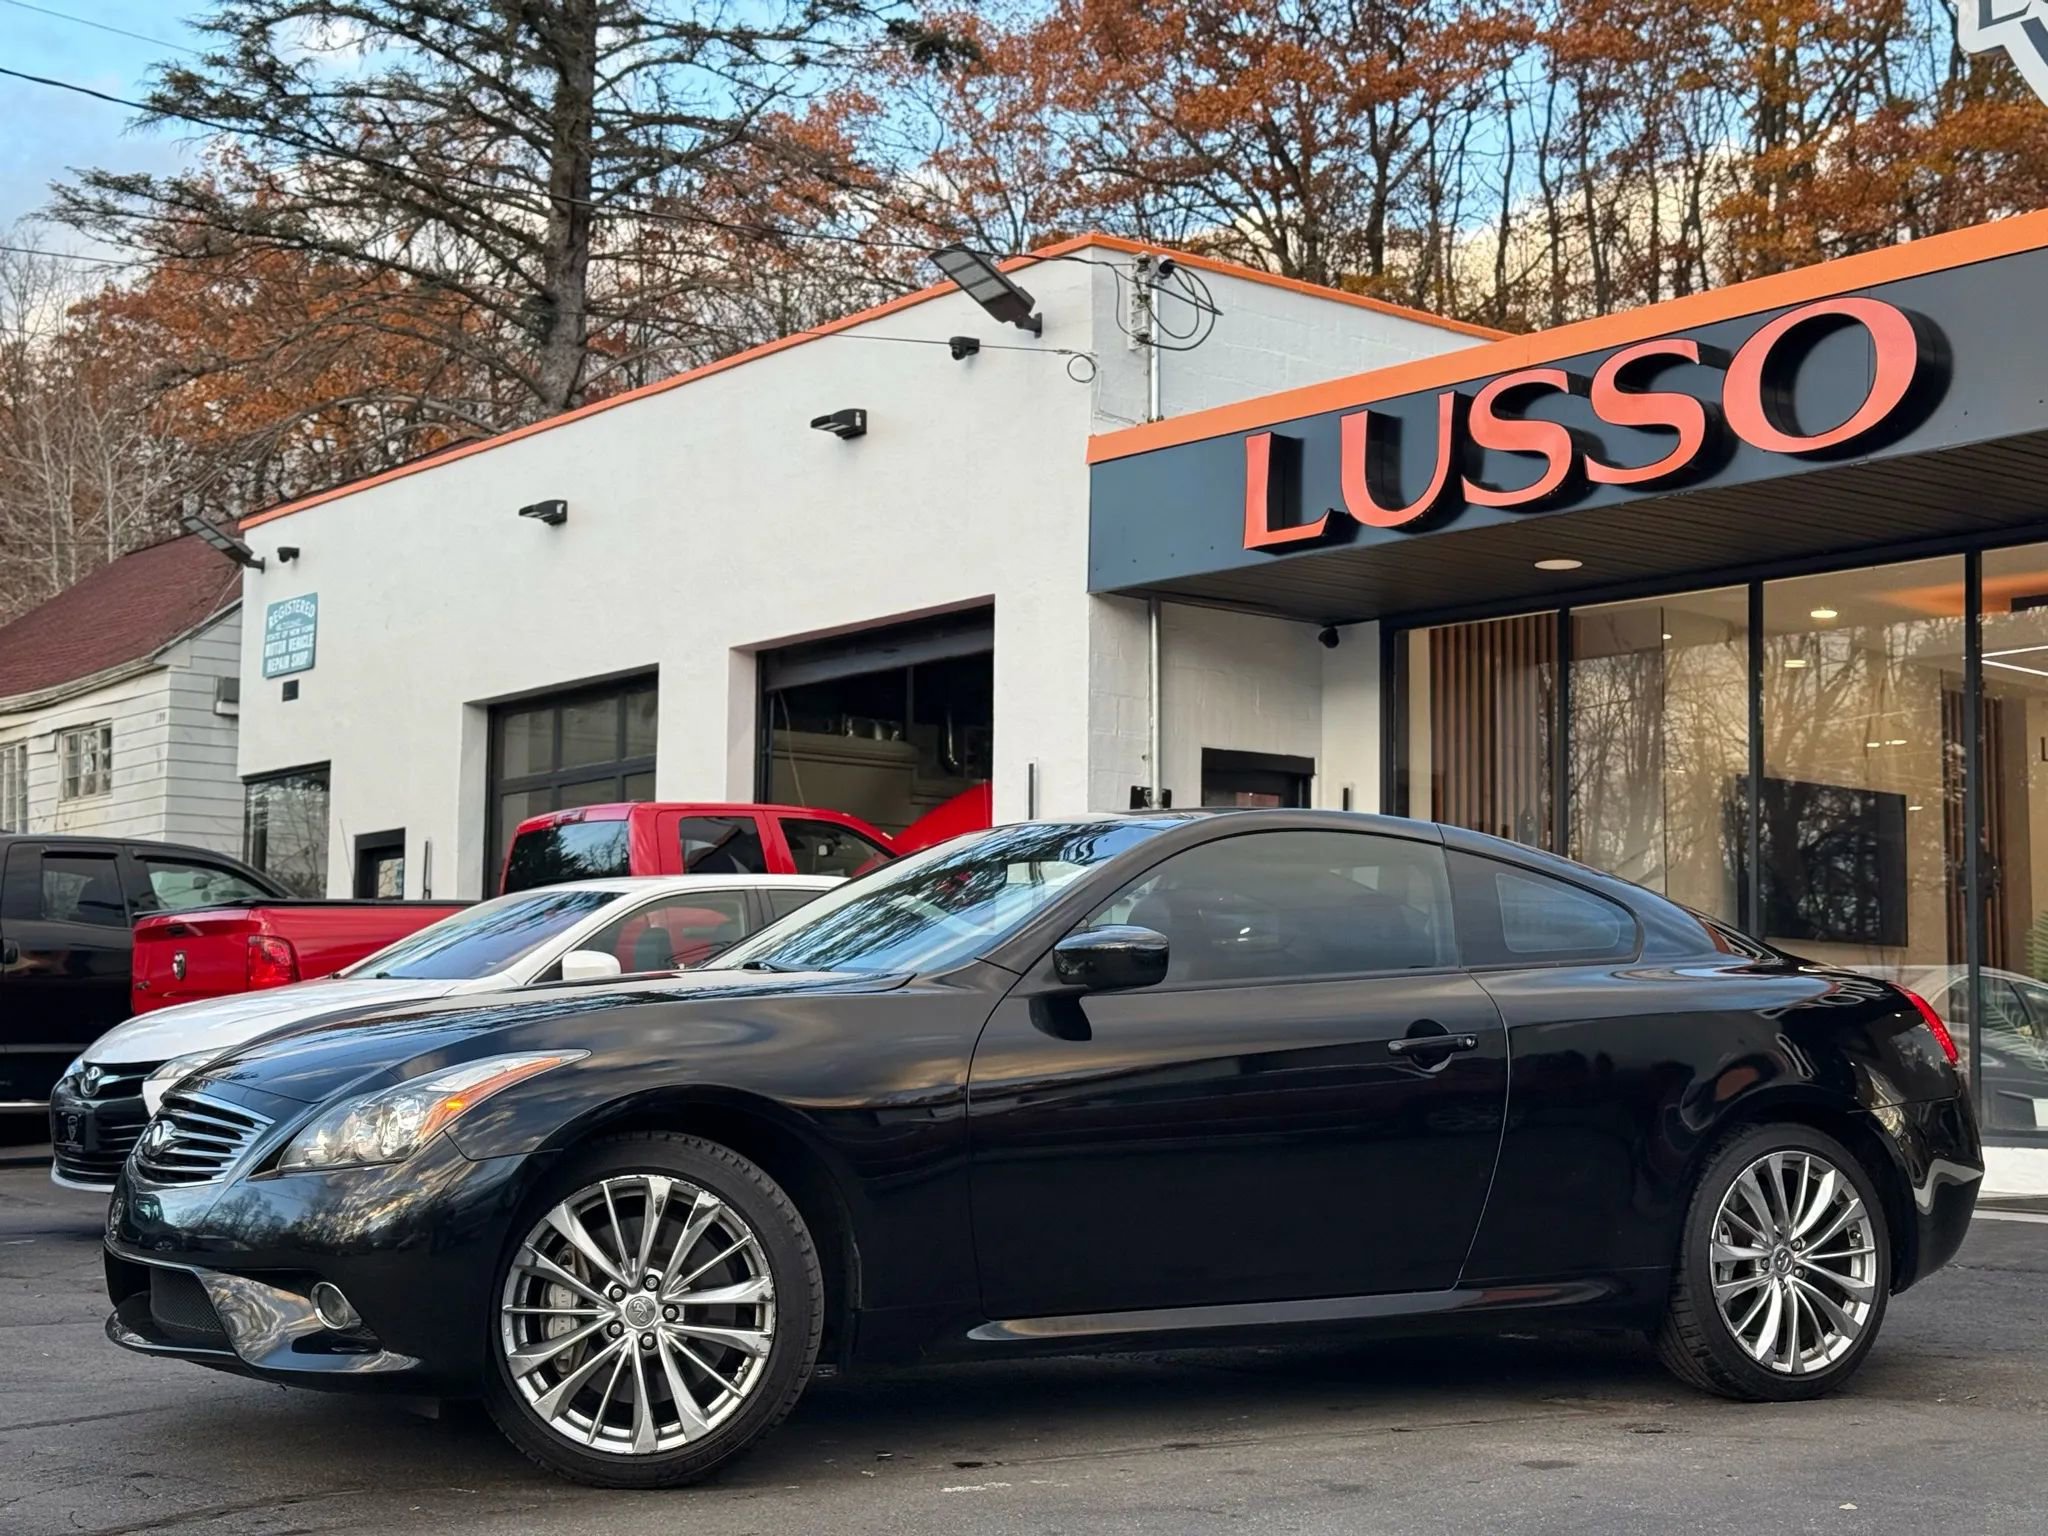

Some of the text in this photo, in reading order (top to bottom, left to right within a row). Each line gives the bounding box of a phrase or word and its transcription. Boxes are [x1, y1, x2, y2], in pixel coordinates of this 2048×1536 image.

[1243, 297, 1920, 551] LUSSO
[268, 600, 315, 629] REGISTERED
[288, 633, 314, 651] VEHICLE
[267, 650, 308, 673] REPAIR SHOP
